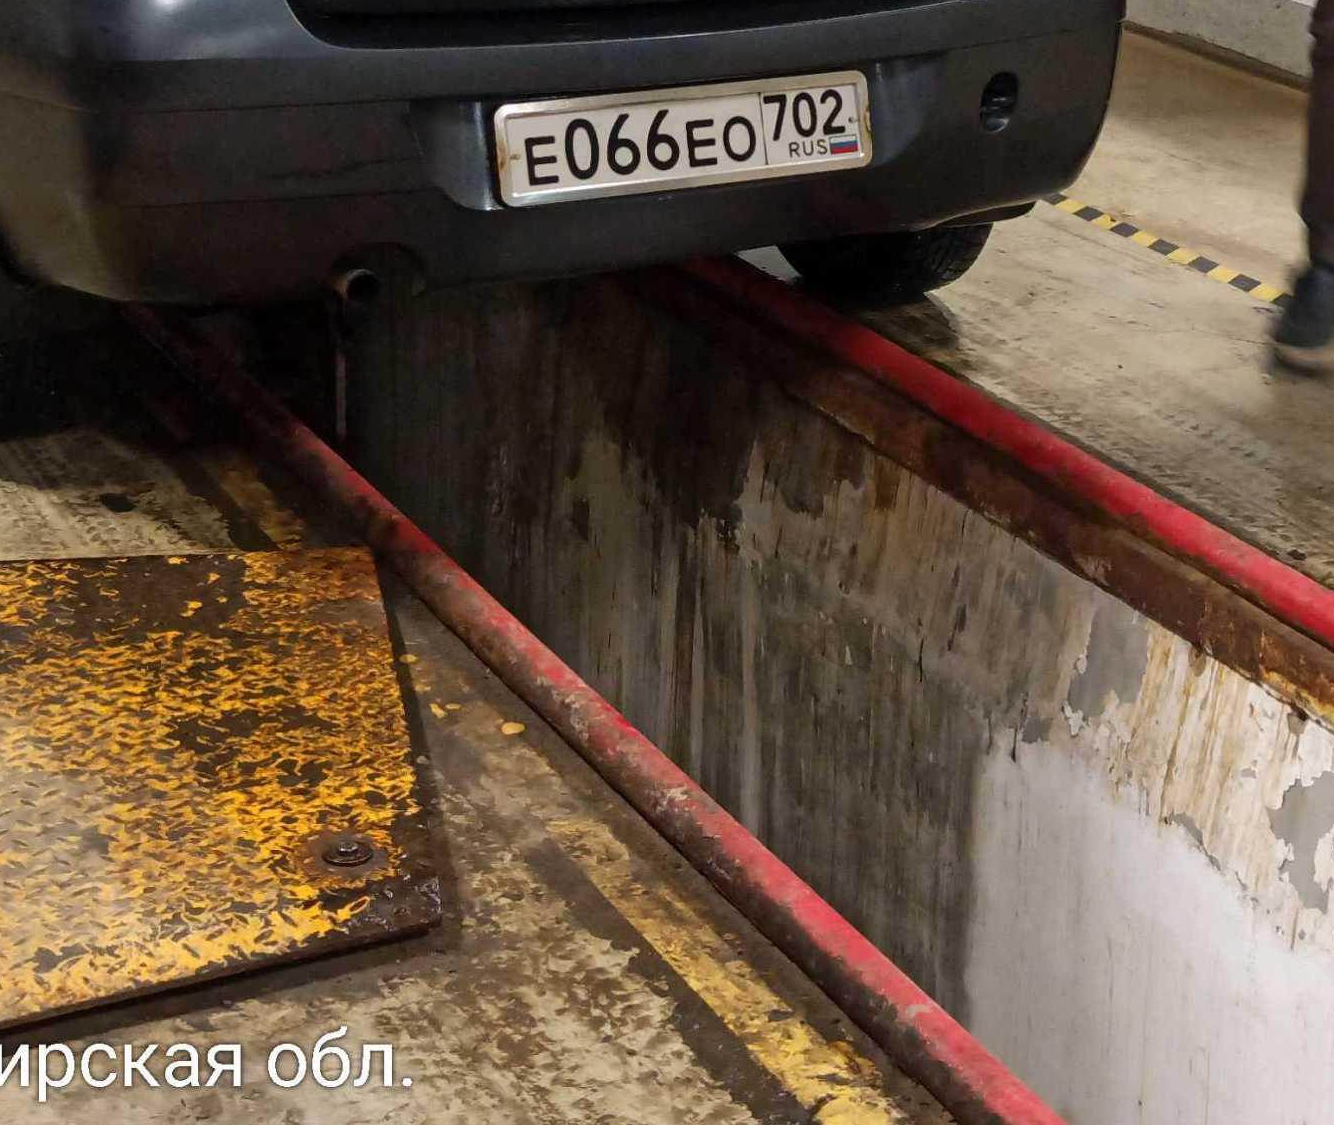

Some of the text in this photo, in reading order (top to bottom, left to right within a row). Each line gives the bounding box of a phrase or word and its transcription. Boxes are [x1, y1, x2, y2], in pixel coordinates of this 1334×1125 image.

[524, 89, 846, 186] Е066ЕО 702
[788, 138, 829, 158] RUS
